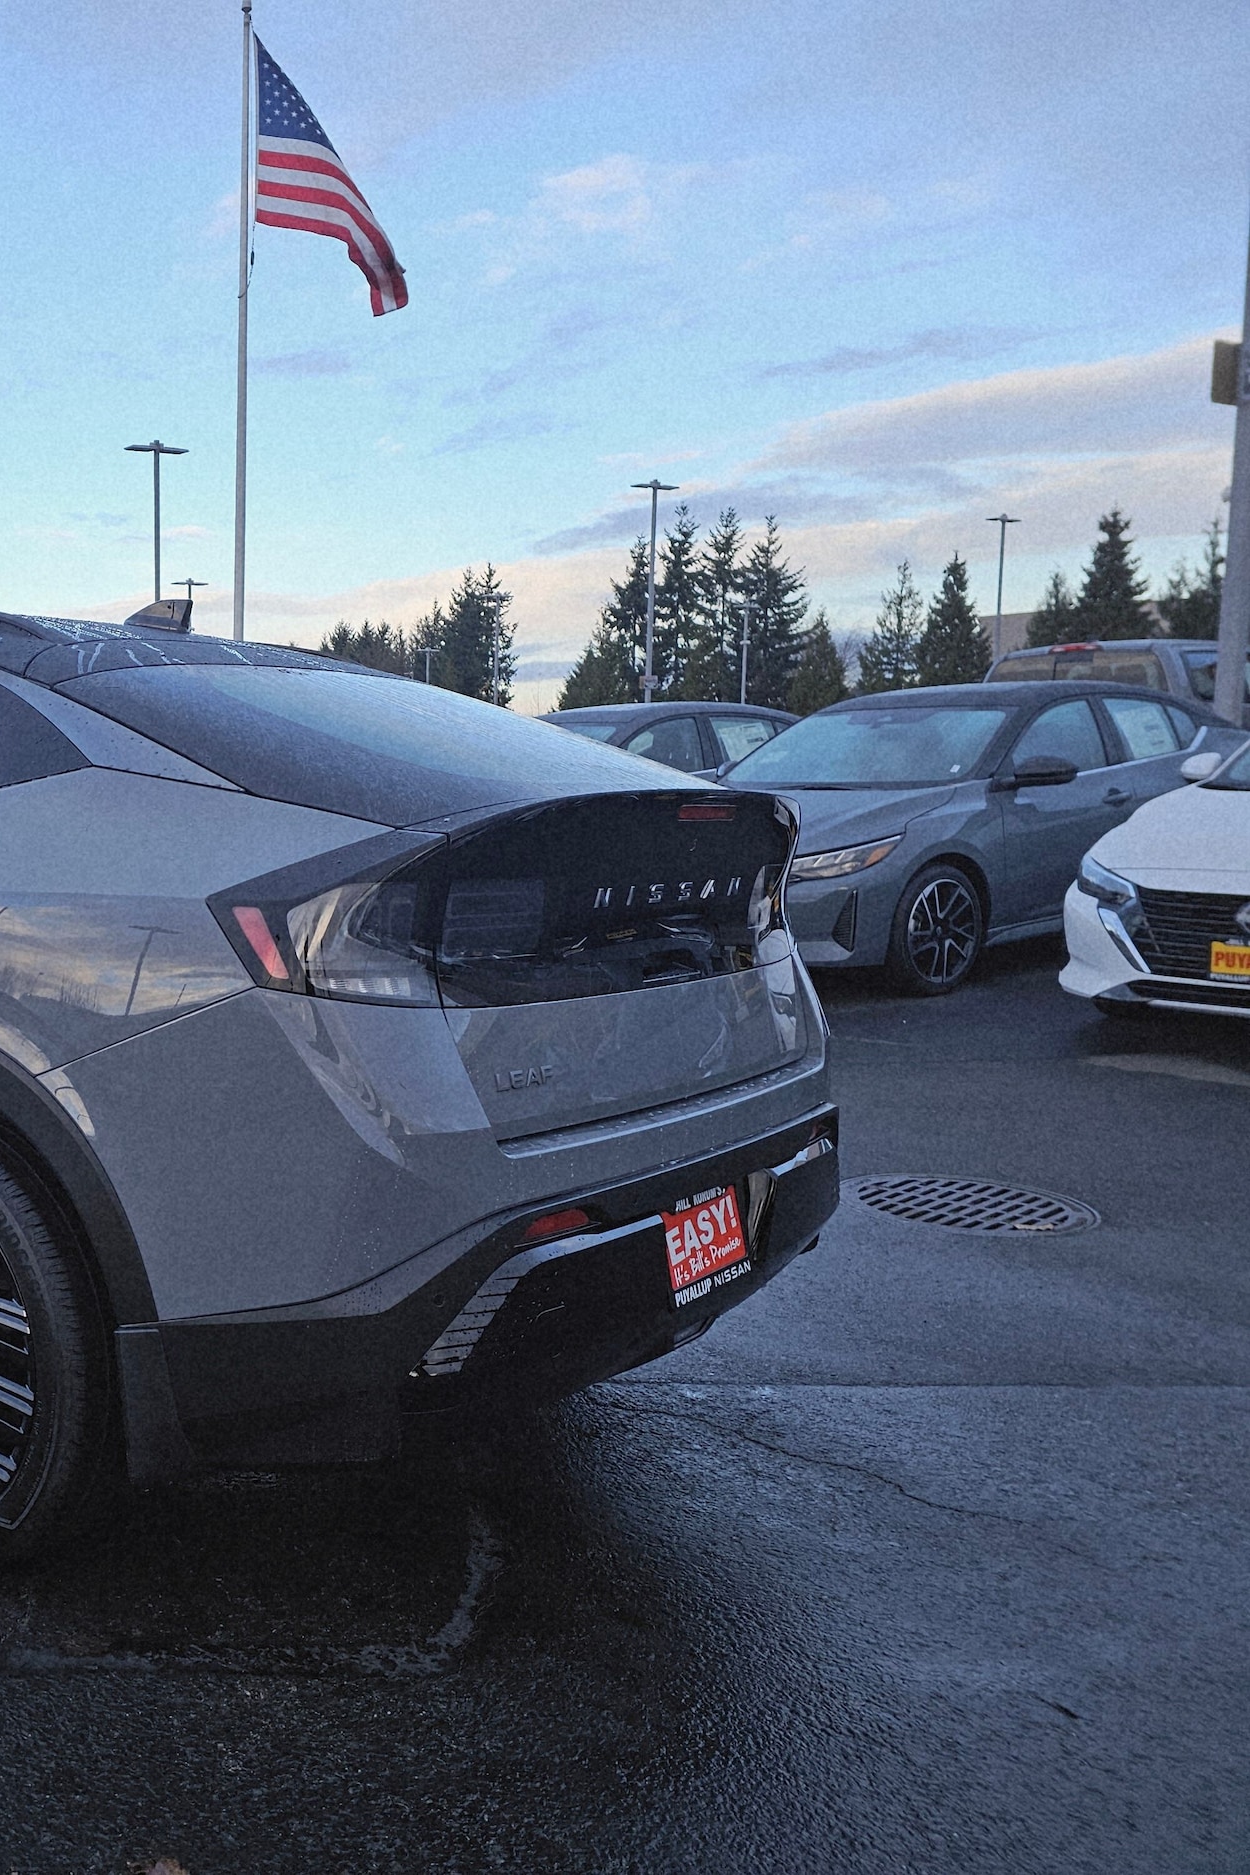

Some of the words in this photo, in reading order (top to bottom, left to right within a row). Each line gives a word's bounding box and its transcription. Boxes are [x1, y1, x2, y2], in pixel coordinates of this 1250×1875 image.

[593, 876, 741, 908] NISSAN
[494, 1065, 553, 1092] LEAF
[675, 1197, 691, 1212] BILL
[665, 1194, 737, 1267] EASY!
[673, 1264, 690, 1288] It's
[689, 1249, 711, 1277] Bill's
[709, 1237, 742, 1265] Promise
[674, 1277, 712, 1308] PUYALLUP
[713, 1259, 752, 1288] NISSAN
